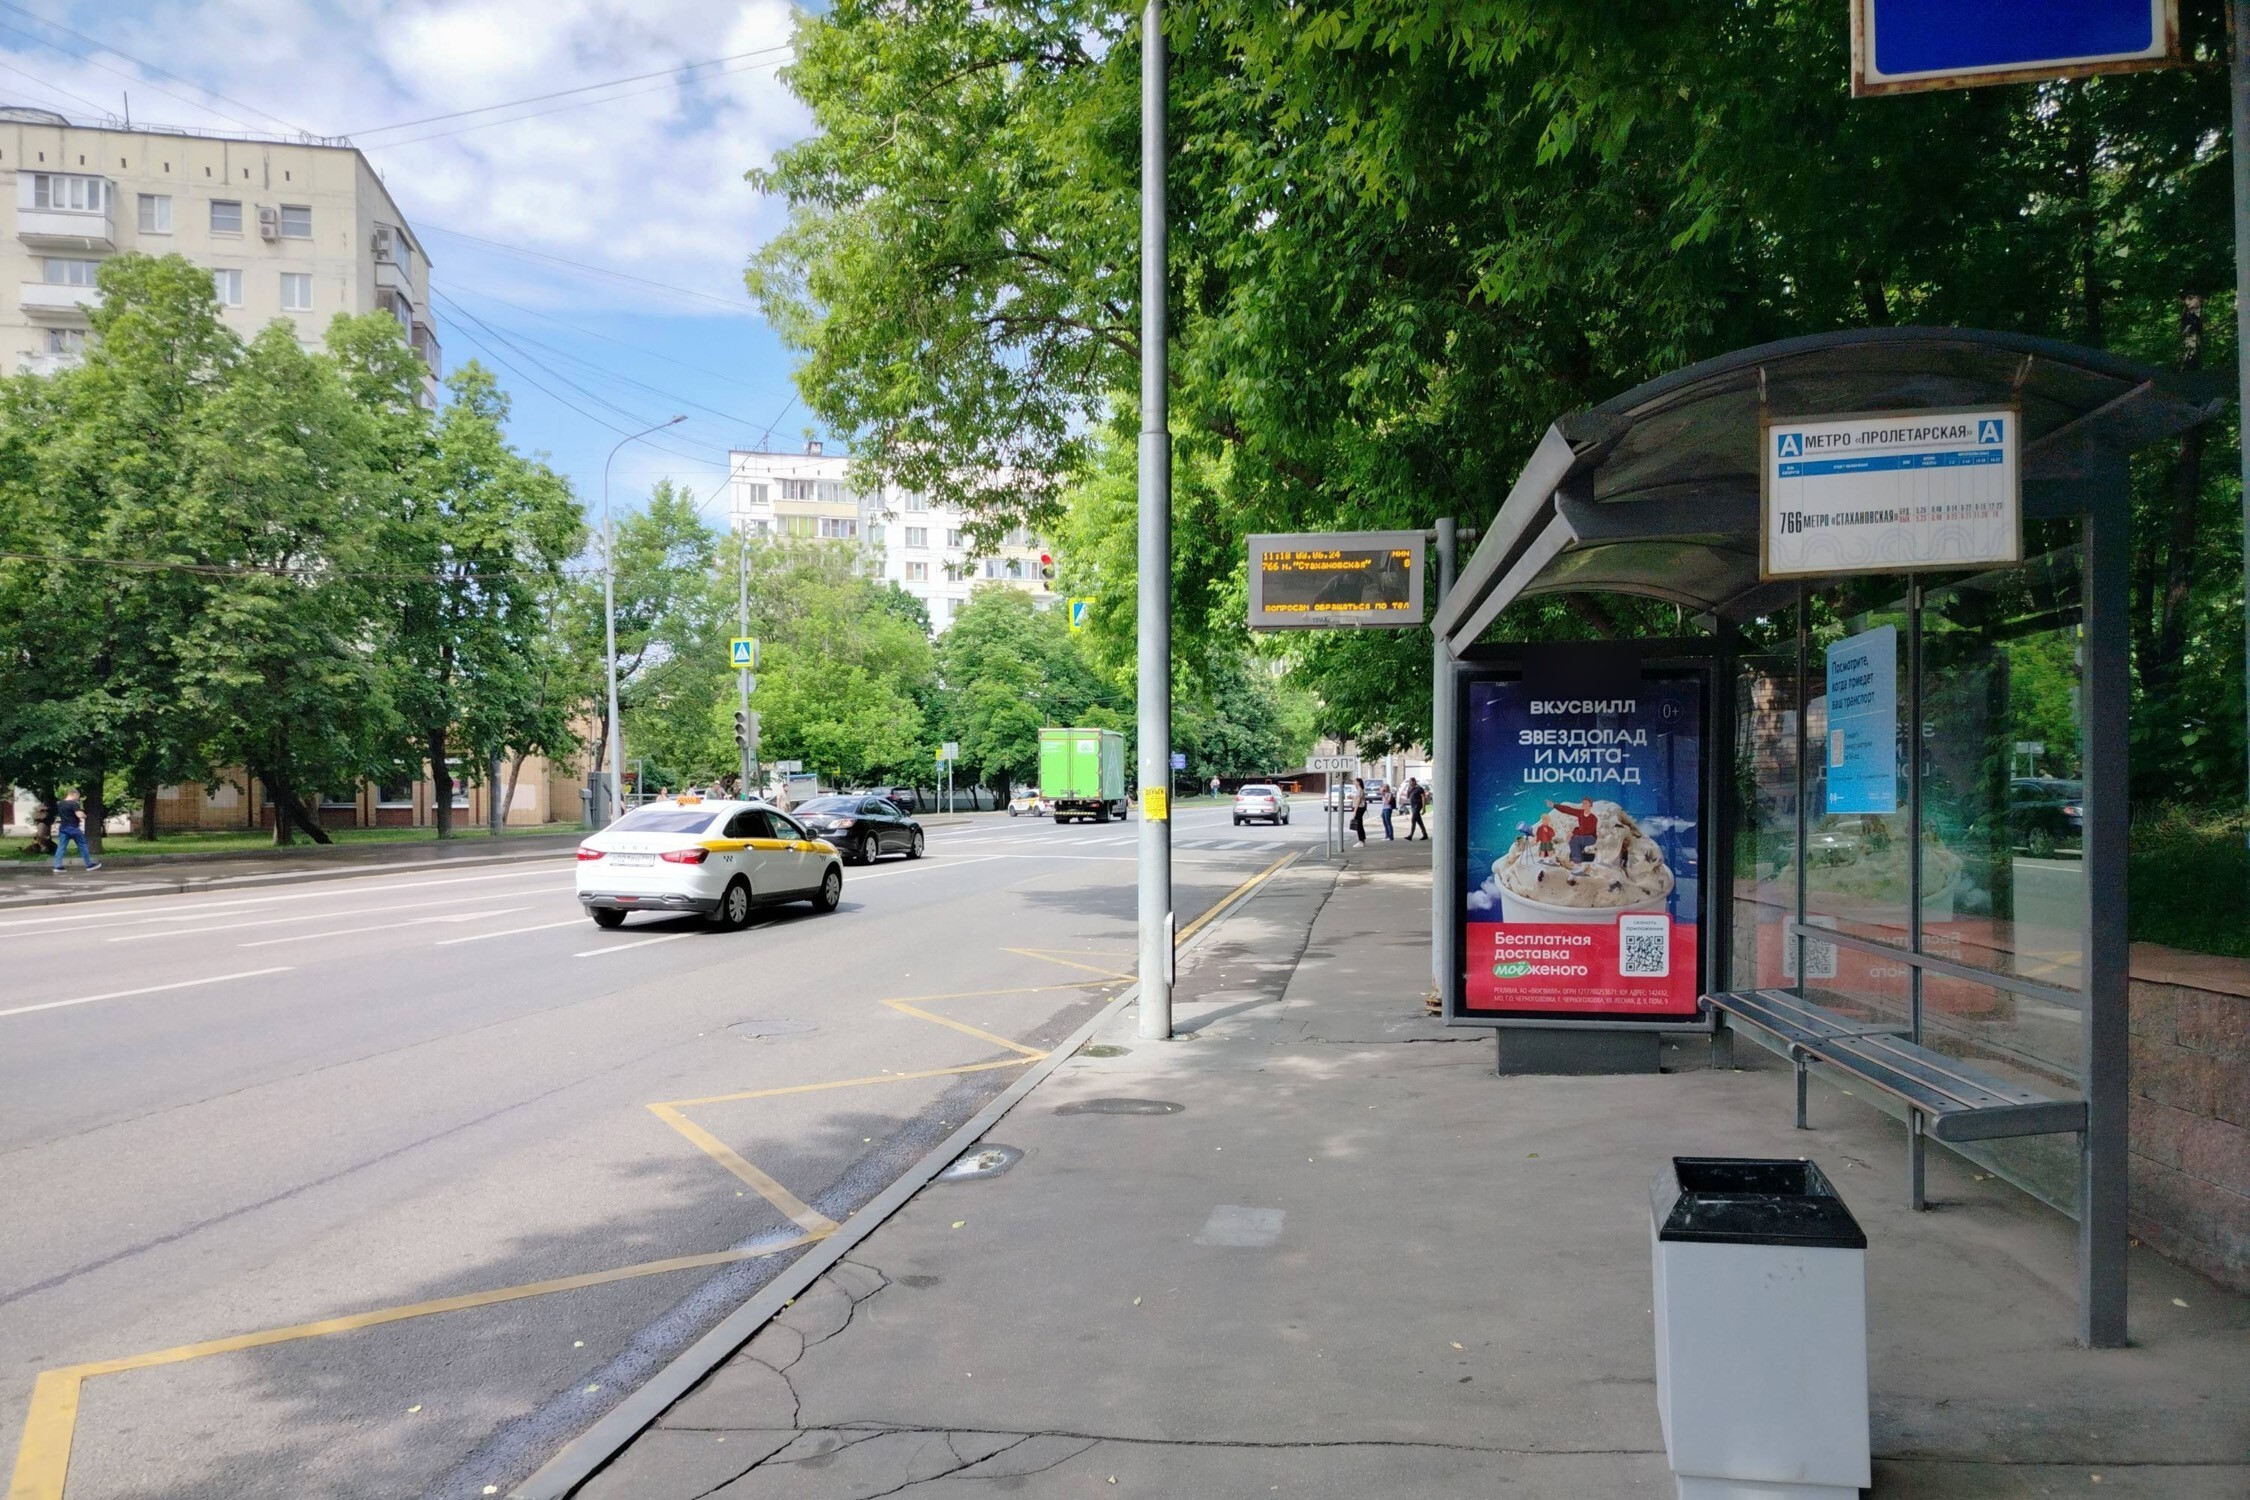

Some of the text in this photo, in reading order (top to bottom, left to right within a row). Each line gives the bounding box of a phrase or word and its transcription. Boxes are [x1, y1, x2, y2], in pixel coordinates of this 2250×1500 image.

[1805, 433, 1851, 449] МЕТРО
[1855, 425, 1973, 445] «ПРОЛЕТАРСКАЯ»
[1779, 511, 1802, 534] 766
[1804, 509, 1899, 528] МЕТРО «СТАХАНОВСКАЯ»
[1262, 561, 1279, 571] 766
[1375, 602, 1387, 611] по
[1831, 653, 1869, 675] Посмотрите,
[1832, 671, 1874, 693] когда приедет
[1530, 699, 1637, 715] ВКУСВИЛЛ
[1832, 690, 1876, 711] ваш транспорт
[1663, 703, 1680, 719] 0+
[1518, 728, 1648, 748] ЗВЕЗДОПАД
[1314, 758, 1348, 770] СТОП
[1534, 749, 1553, 764] И
[1523, 766, 1641, 785] ШОКОЛАД
[1494, 932, 1592, 946] Бесплатная
[1494, 948, 1570, 960] доставка
